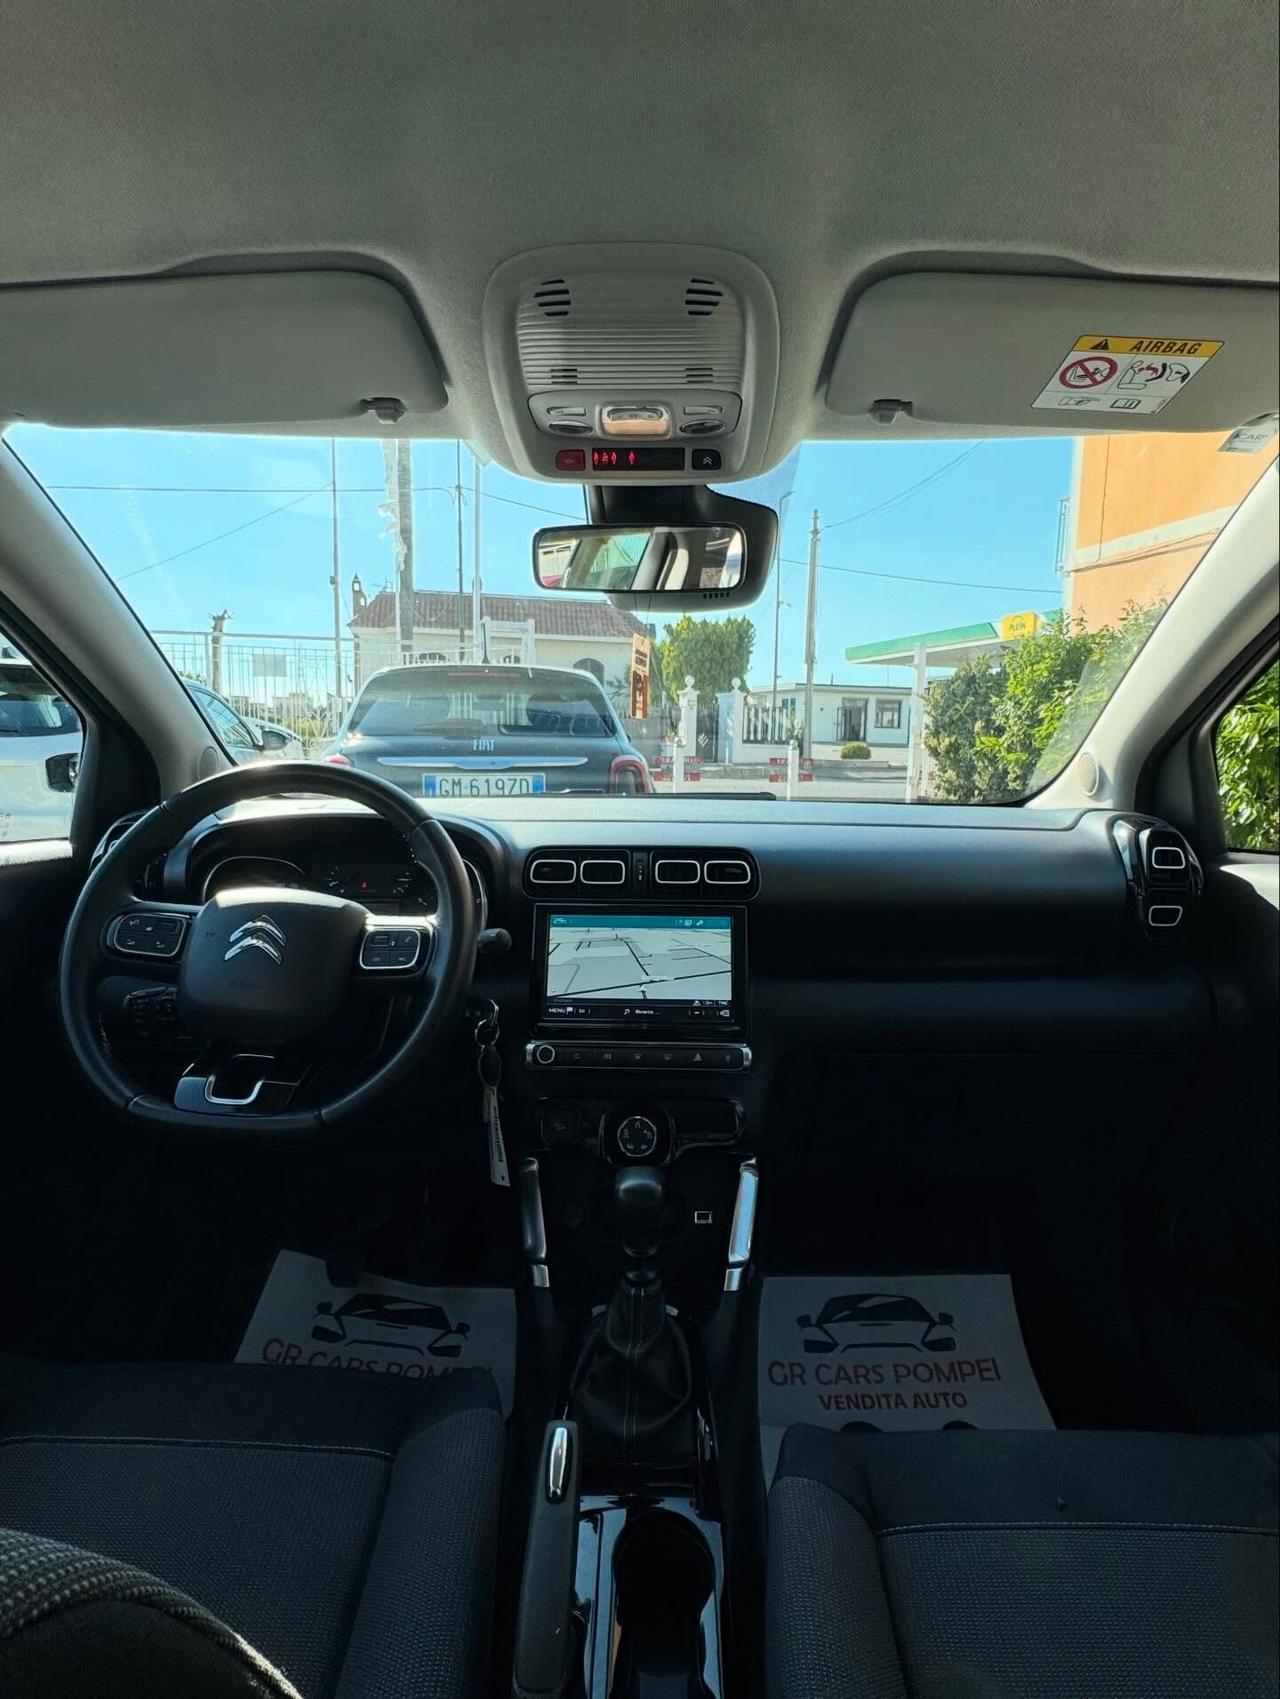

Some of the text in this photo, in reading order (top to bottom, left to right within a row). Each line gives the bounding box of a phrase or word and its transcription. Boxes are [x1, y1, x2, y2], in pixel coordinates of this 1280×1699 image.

[1128, 340, 1202, 355] AIRBAG
[473, 738, 495, 751] FIAT
[439, 777, 462, 797] GM
[768, 1357, 1002, 1387] GR CARS POMPEI
[817, 1391, 968, 1411] VENDITA AUTO
